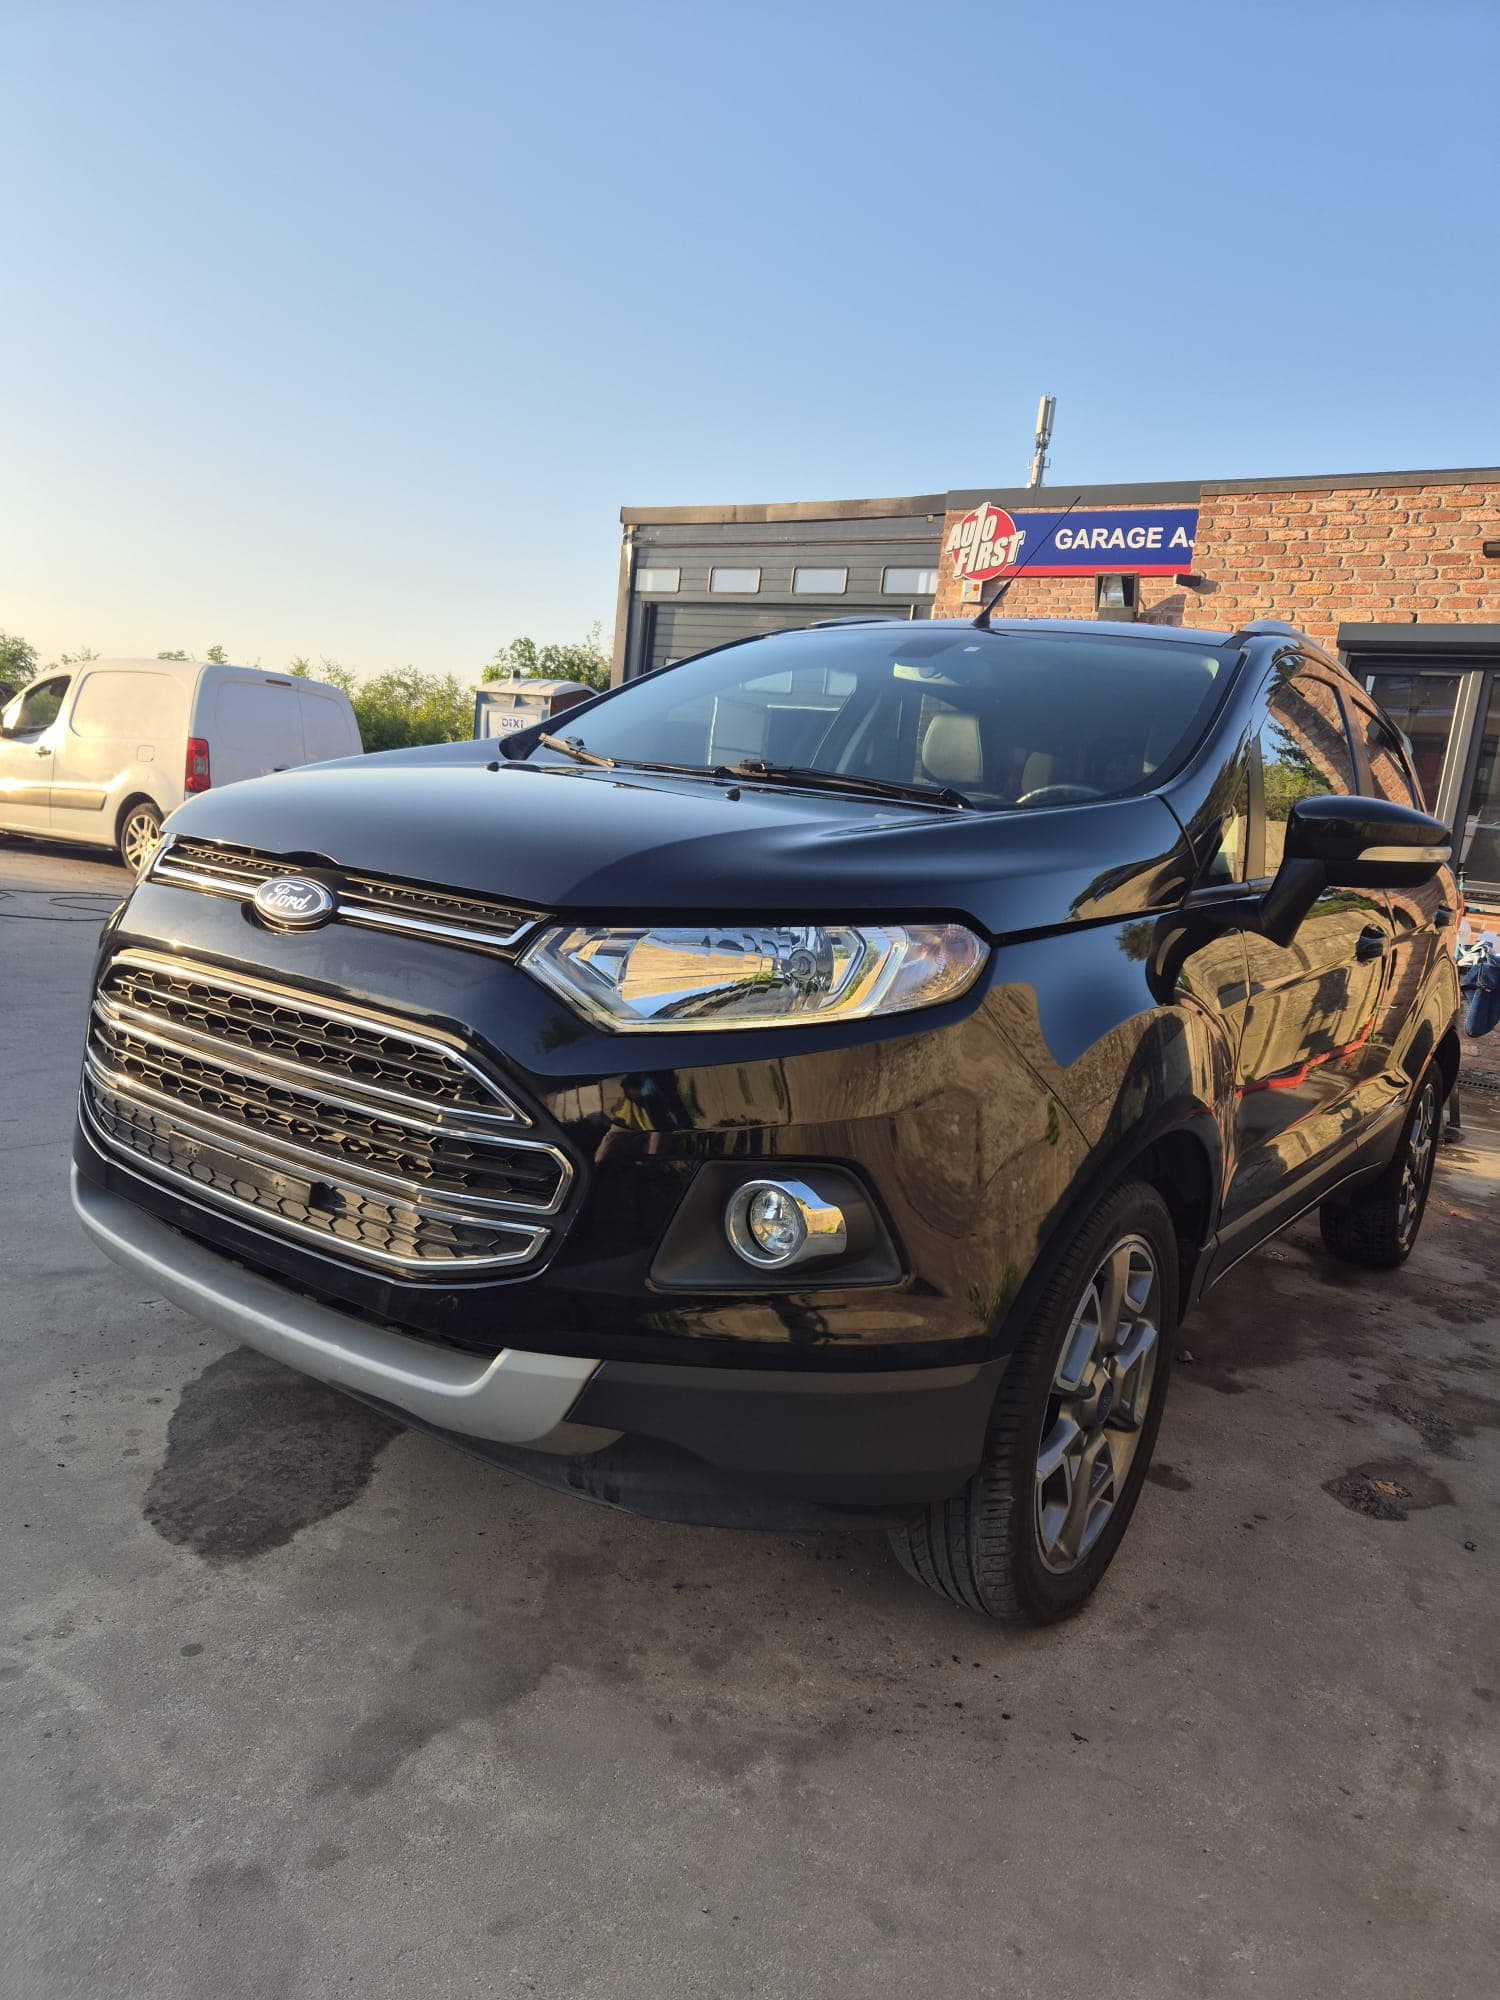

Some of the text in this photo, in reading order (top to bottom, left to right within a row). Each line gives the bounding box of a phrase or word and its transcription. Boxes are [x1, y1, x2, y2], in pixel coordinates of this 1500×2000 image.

[1055, 526, 1163, 549] GARAGE
[953, 531, 1025, 577] FIRST
[266, 883, 312, 910] Ford
